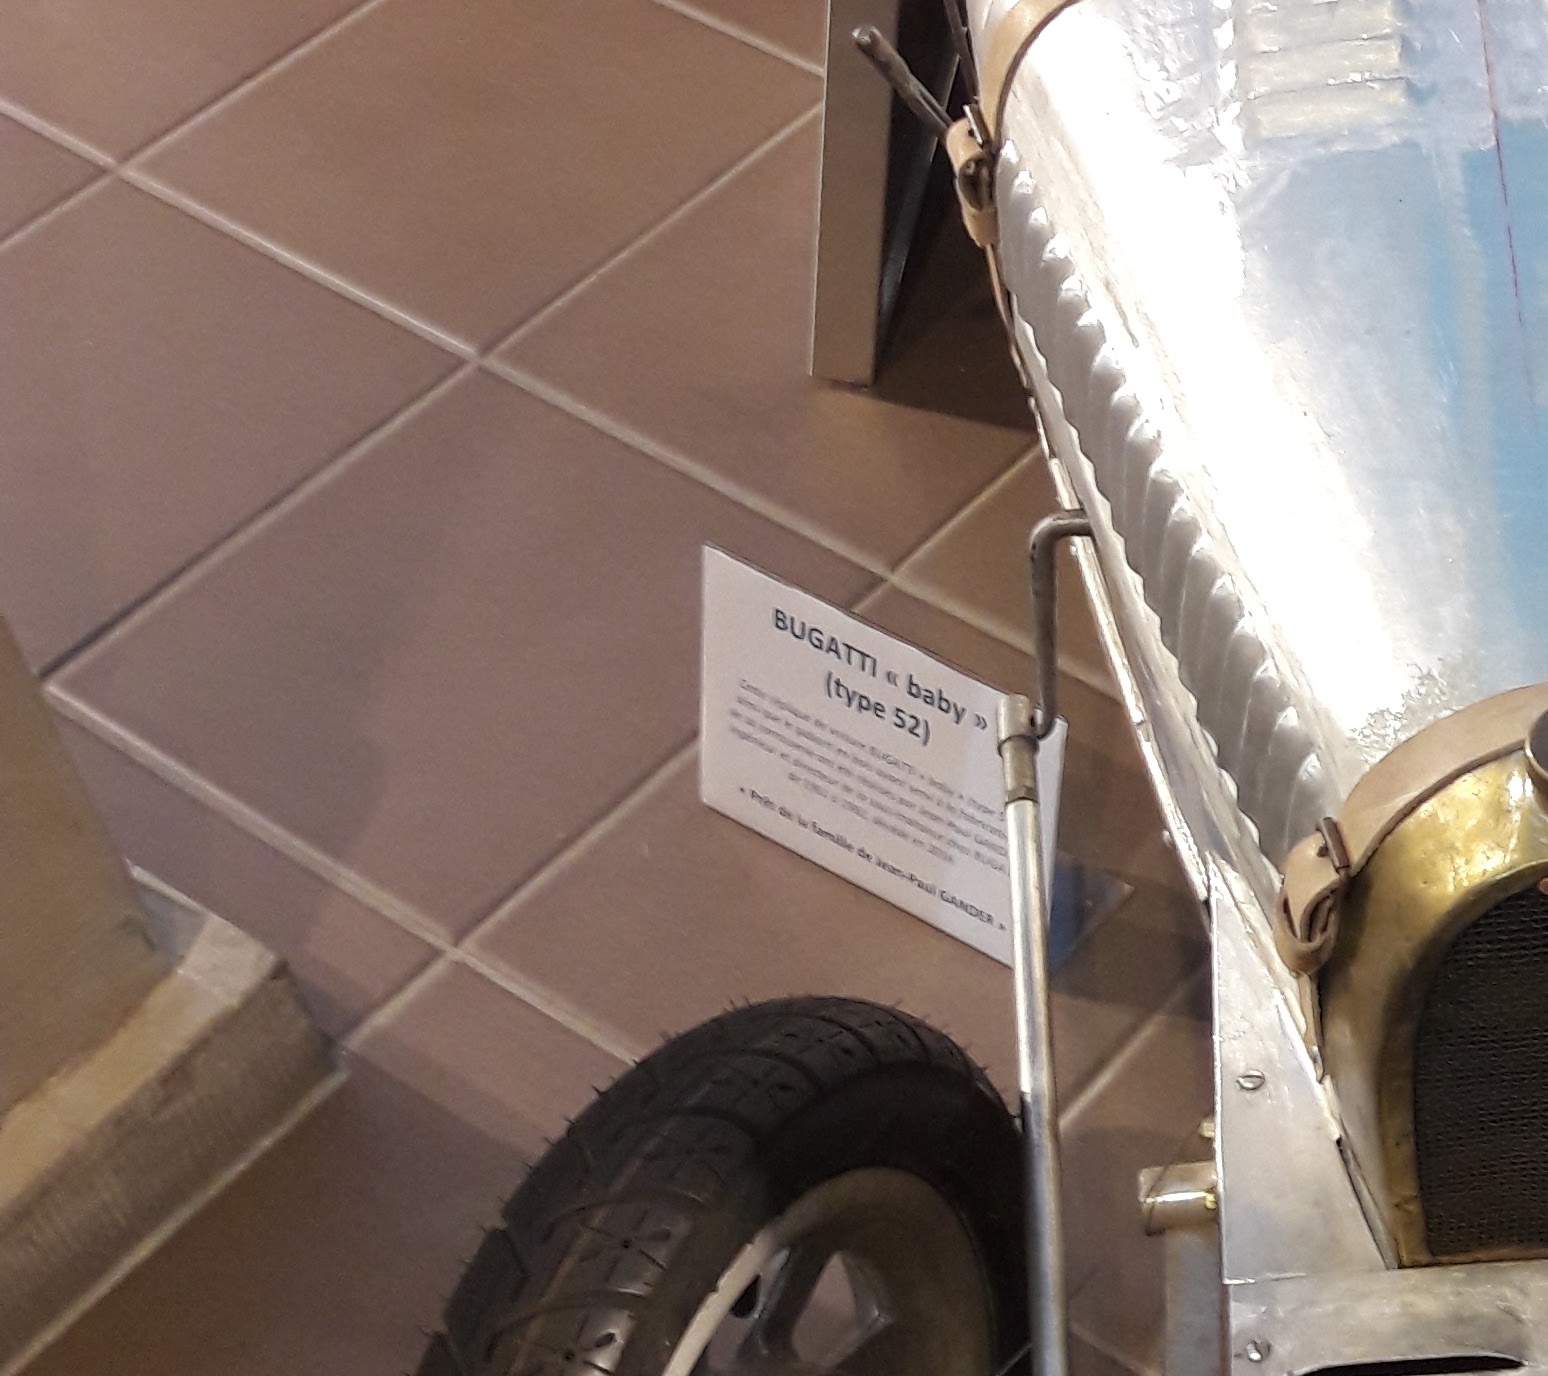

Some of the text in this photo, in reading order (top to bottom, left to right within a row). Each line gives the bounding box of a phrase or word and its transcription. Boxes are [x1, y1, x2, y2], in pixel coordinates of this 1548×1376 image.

[772, 608, 878, 677] BUGATTI
[907, 673, 967, 726] baby
[825, 671, 886, 721] (type
[893, 710, 931, 746] 52)
